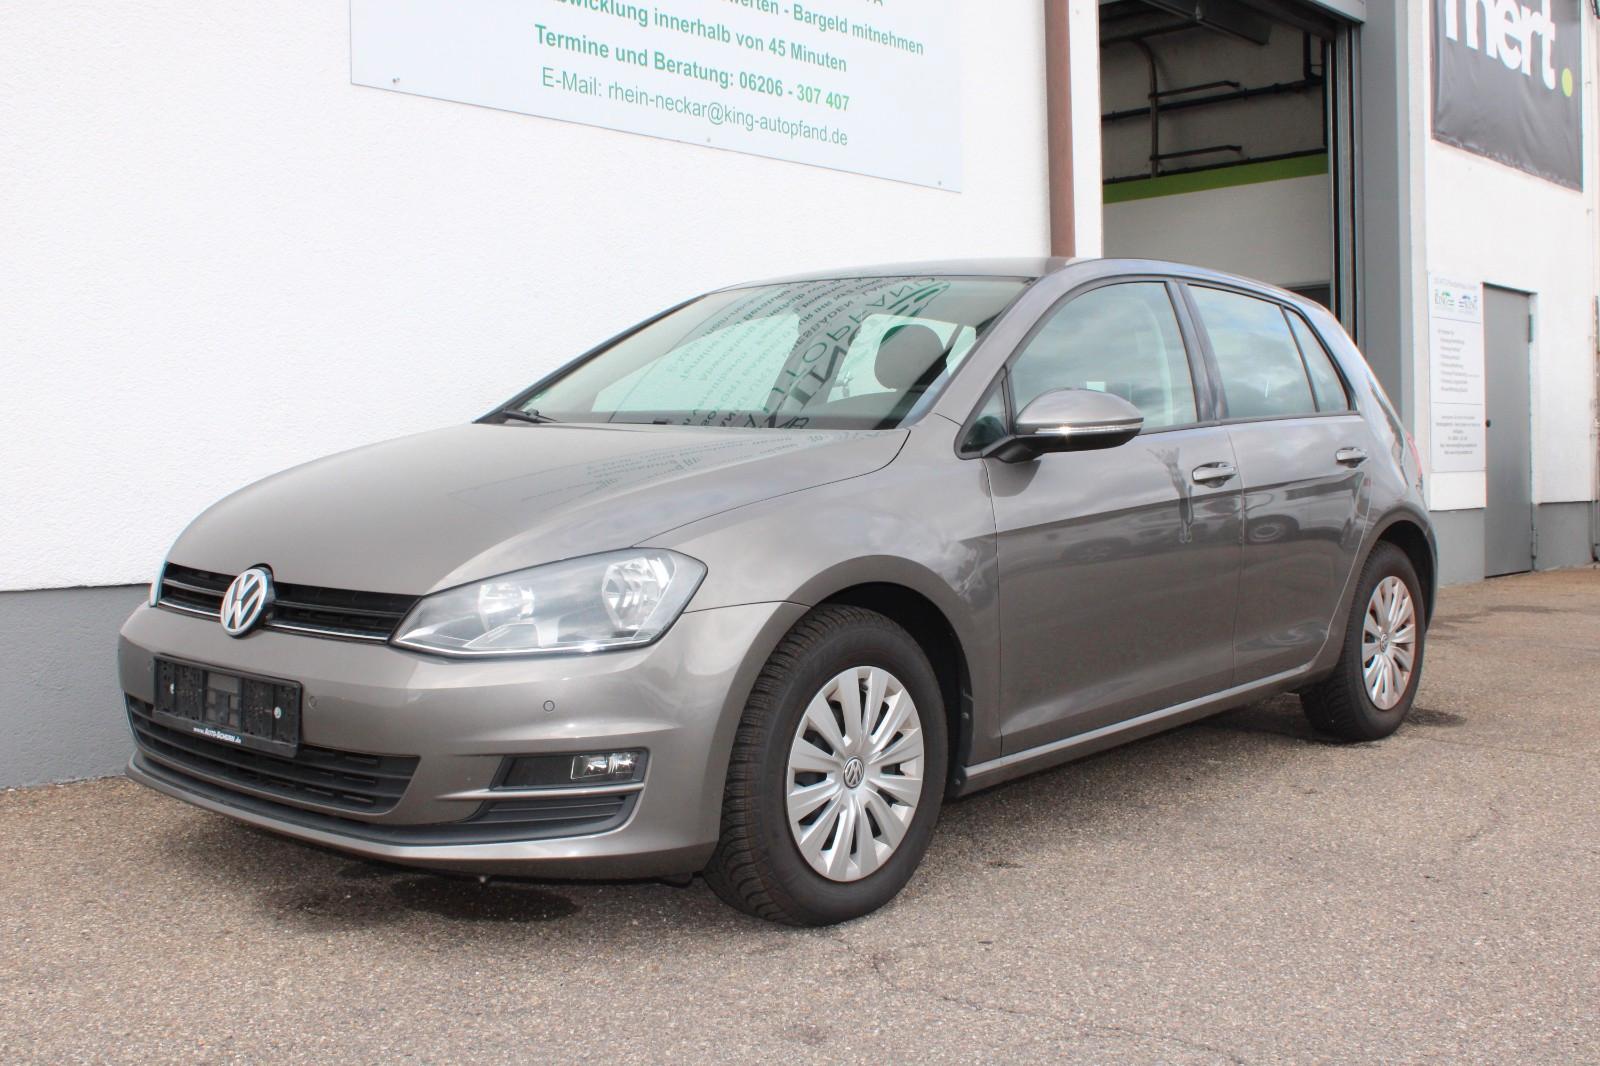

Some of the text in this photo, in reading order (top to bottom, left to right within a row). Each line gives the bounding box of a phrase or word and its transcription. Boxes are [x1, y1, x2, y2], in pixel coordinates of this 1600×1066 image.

[534, 24, 609, 58] Termine
[615, 46, 648, 67] und
[654, 51, 734, 89] Beratung:
[739, 71, 784, 97] 06206
[796, 84, 821, 105] 307
[825, 91, 850, 111] 407
[558, 0, 847, 72] cklung innerhalb von 45 Minuten
[793, 4, 848, 34] Bargeld
[852, 23, 924, 56] mitnehmen
[542, 66, 848, 146] E-Mail: rhein-neckar@king-autopfand.de
